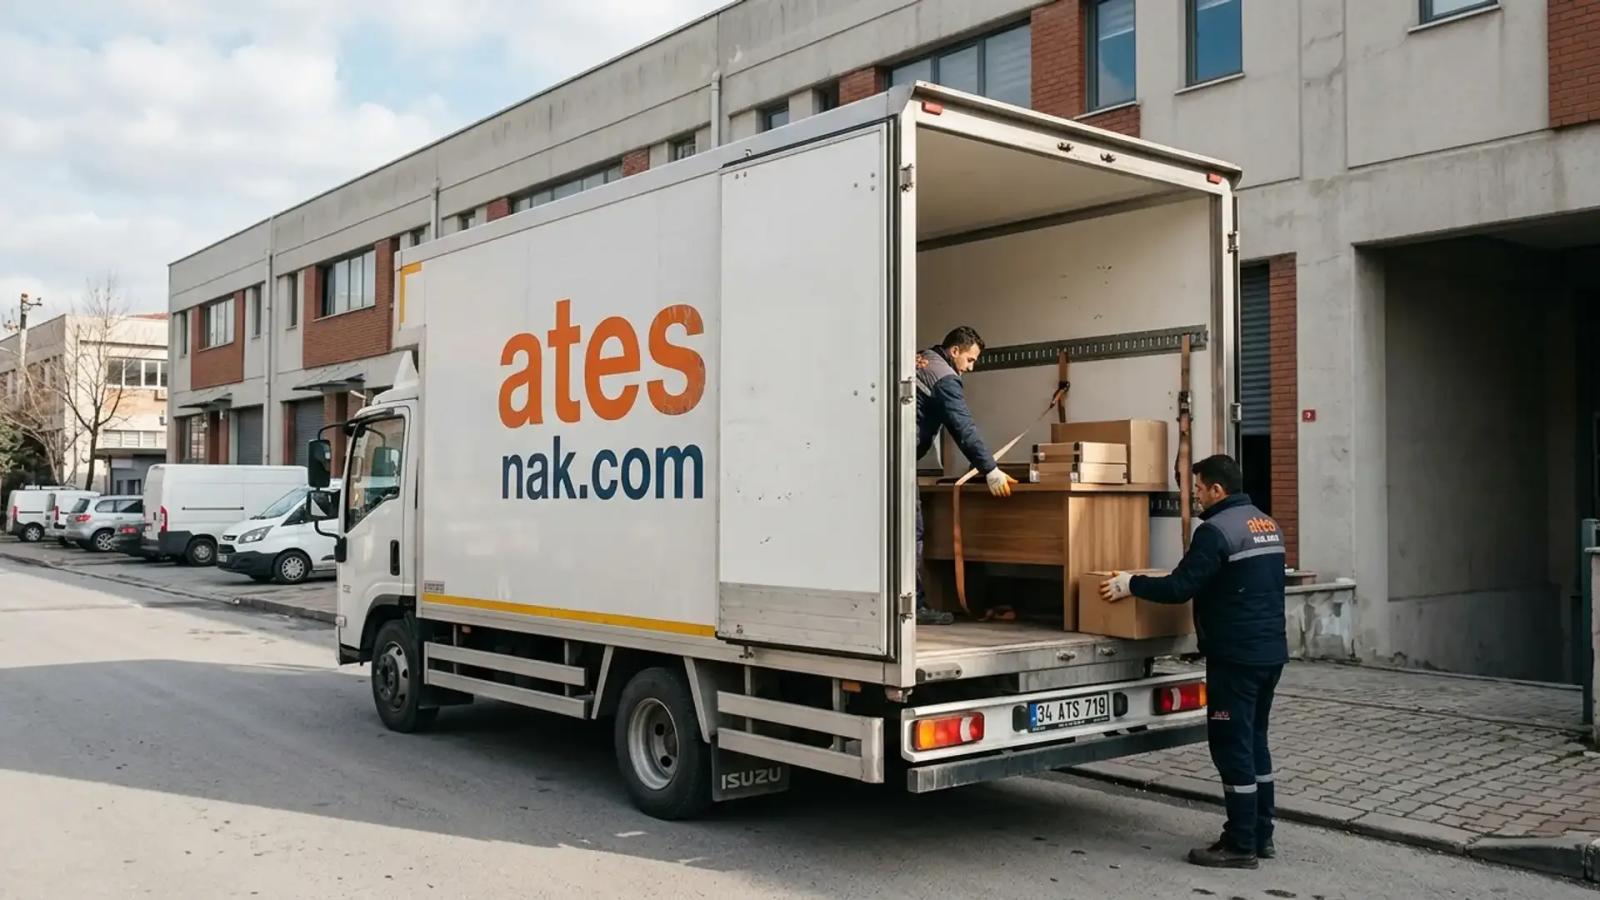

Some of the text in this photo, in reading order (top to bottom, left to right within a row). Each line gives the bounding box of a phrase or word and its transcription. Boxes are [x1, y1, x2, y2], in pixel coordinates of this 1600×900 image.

[498, 298, 706, 428] ates
[502, 435, 704, 501] nak.com
[1037, 697, 1105, 722] 34 ATS 719
[721, 767, 781, 790] ISUZU
